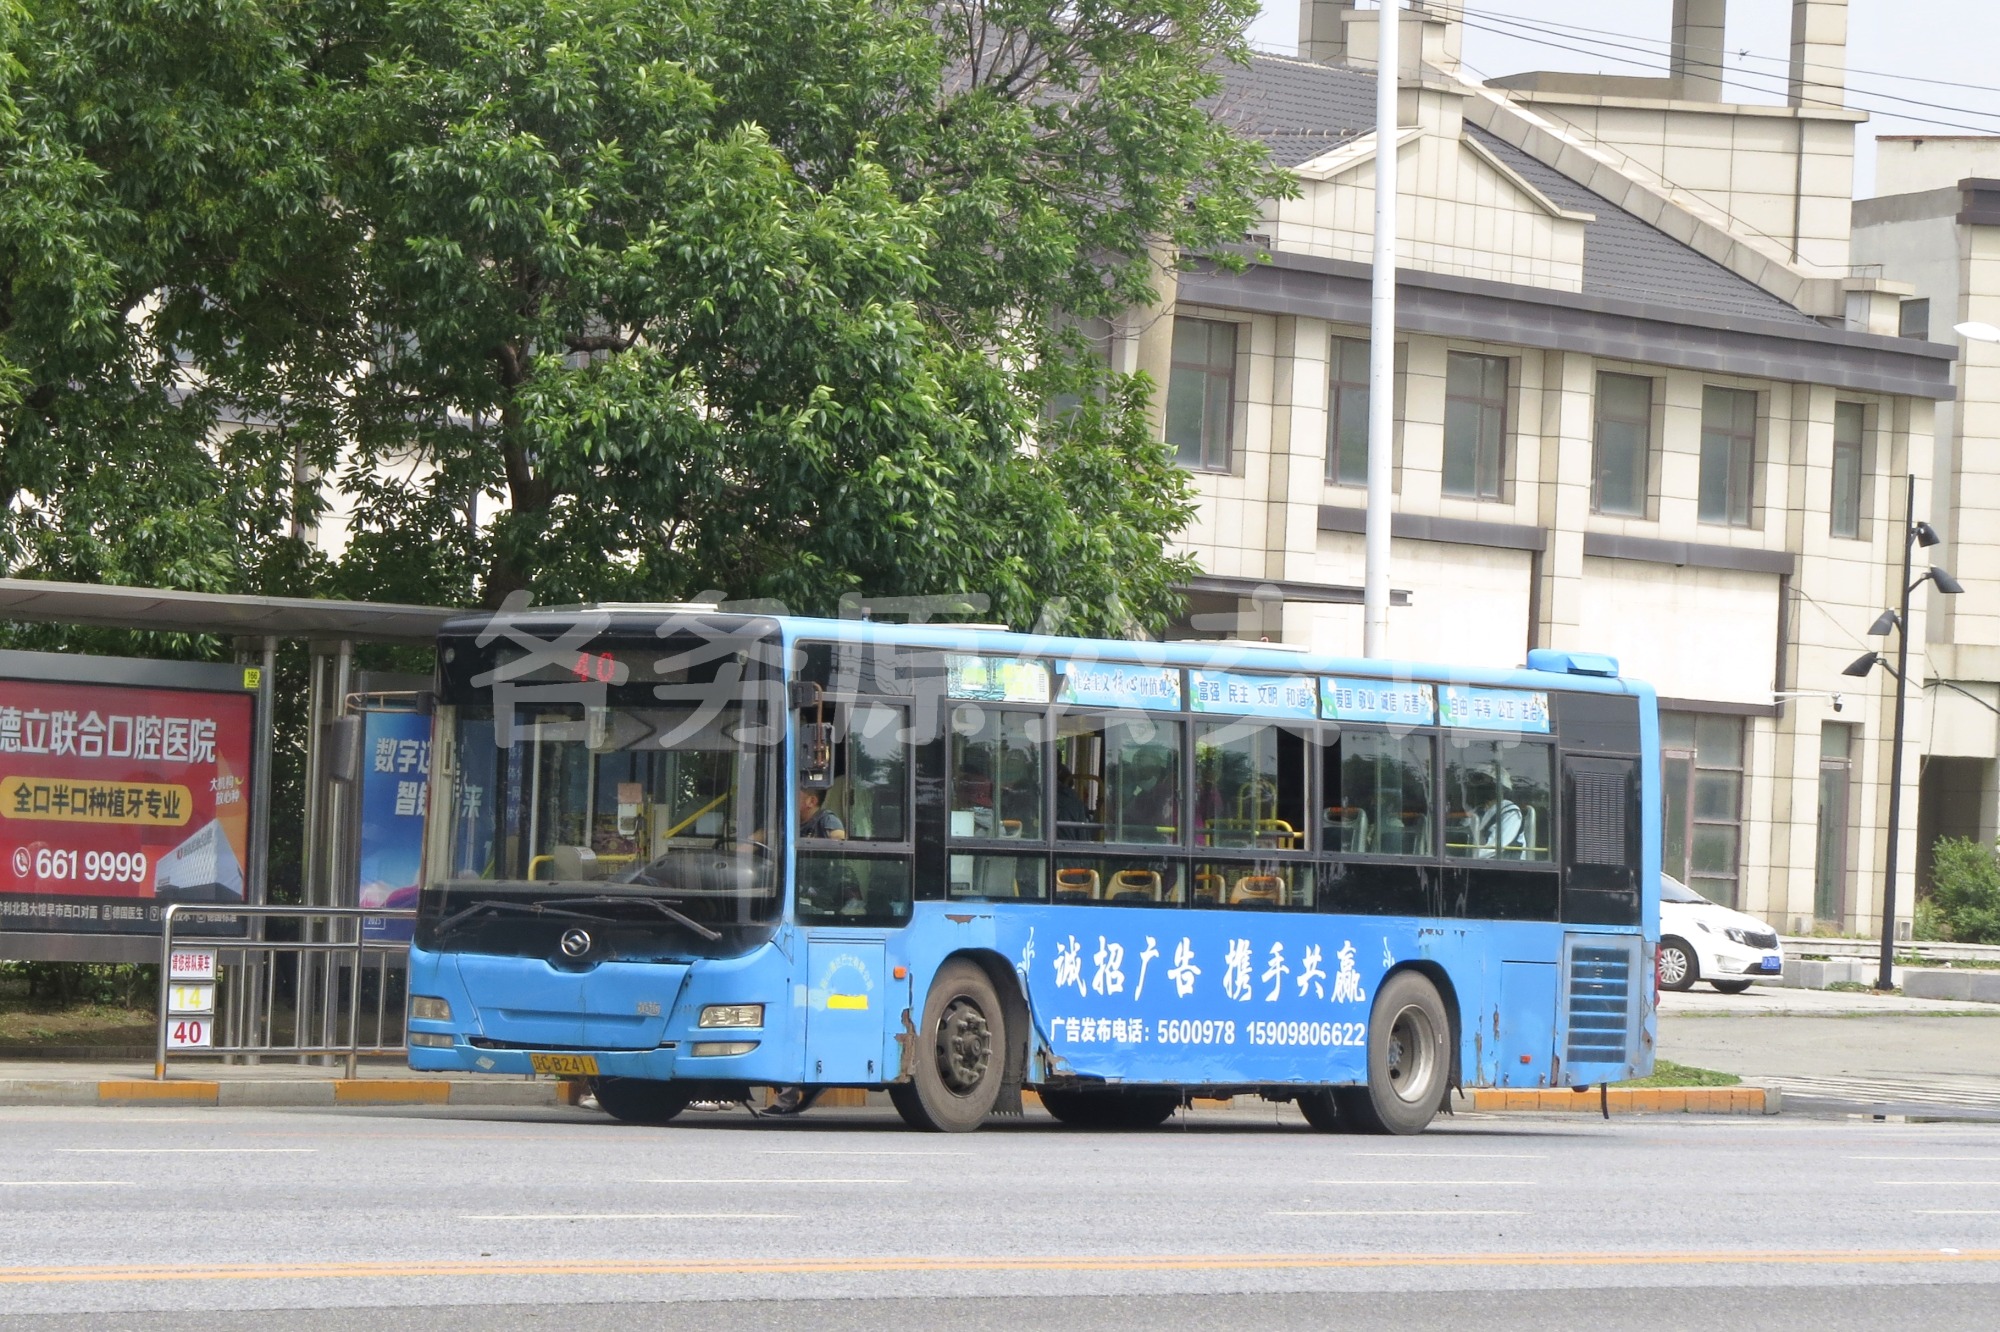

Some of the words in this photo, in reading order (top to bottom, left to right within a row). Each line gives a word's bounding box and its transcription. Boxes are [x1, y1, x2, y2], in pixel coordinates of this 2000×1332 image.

[574, 652, 615, 682] 40
[1074, 669, 1168, 696] 社会主义核心价值观
[1198, 681, 1219, 702] 富强
[1228, 682, 1248, 704] 民主
[1257, 686, 1277, 706] 文明
[1286, 687, 1306, 708] 和谐
[1336, 689, 1351, 709] 爱国
[1358, 690, 1375, 710] 敬业
[1380, 692, 1397, 711] 诚信
[1403, 694, 1418, 713] 友善
[1451, 696, 1468, 715] 自由
[1474, 697, 1490, 717] 平等
[1497, 700, 1514, 719] 公正
[1521, 701, 1537, 720] 法治
[0, 706, 216, 763] 德立联合口腔医院
[209, 776, 234, 792] 大机构
[13, 783, 180, 819] 全口半口种植牙专业
[215, 789, 240, 806] 放心种
[0, 902, 98, 919] 利北路大馆早市西口对面
[112, 906, 144, 920] 德国医生
[172, 954, 210, 972] 请您排队乘车
[1053, 935, 1201, 1001] 诚招广告
[1223, 938, 1366, 1003] 携手共赢
[176, 986, 201, 1008] 14
[174, 1021, 201, 1043] 40
[1157, 1019, 1236, 1045] 5600978
[1246, 1021, 1366, 1046] 15909806622
